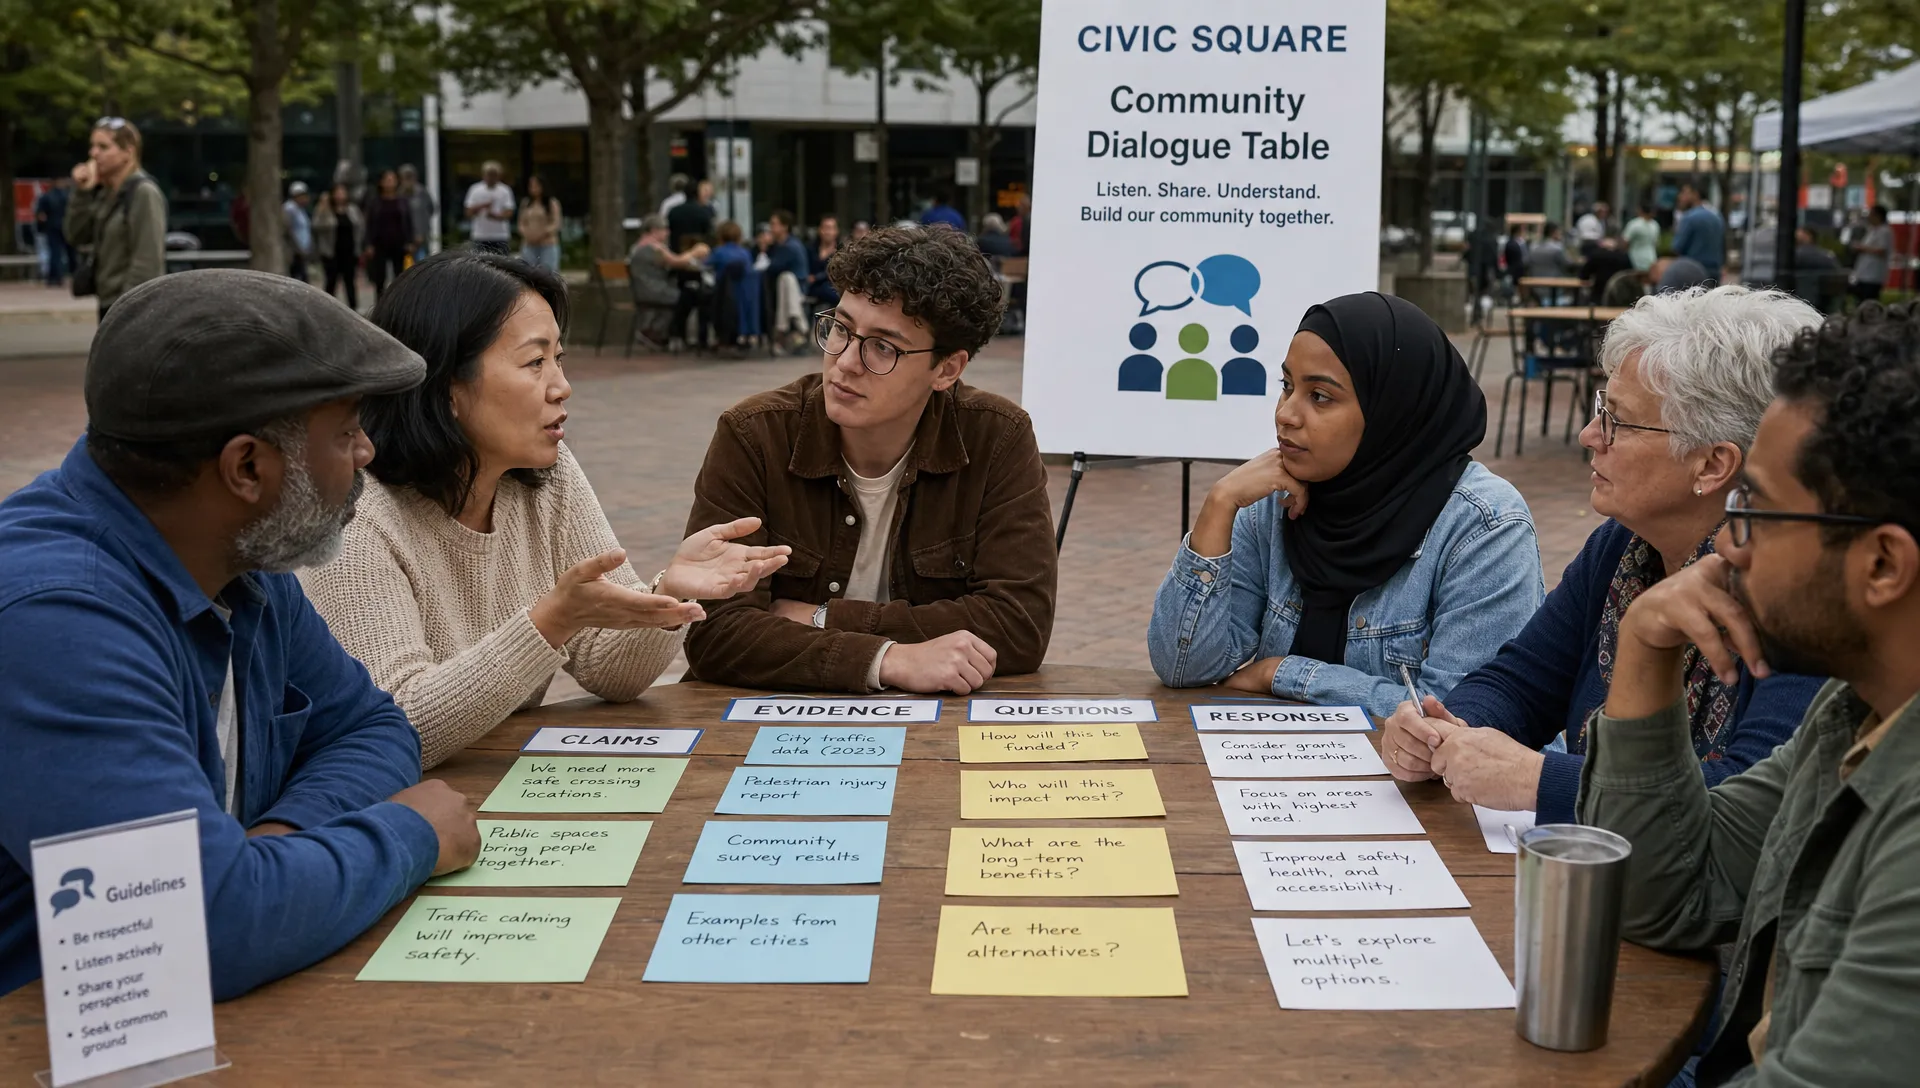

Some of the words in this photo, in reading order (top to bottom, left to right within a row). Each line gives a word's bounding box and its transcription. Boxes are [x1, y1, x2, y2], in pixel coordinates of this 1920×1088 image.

[1078, 25, 1177, 53] CIVIC
[1191, 25, 1347, 55] SQUARE
[1111, 85, 1305, 122] Community
[1088, 130, 1231, 166] Dialogue
[1241, 131, 1329, 160] Table
[1097, 181, 1151, 197] Listen.
[1158, 182, 1211, 198] Share.
[1218, 183, 1320, 199] Understand.
[1081, 206, 1122, 222] Build
[1127, 210, 1155, 222] our
[1160, 208, 1254, 228] community
[1259, 209, 1333, 228] together.
[754, 705, 912, 716] EVIDENCE
[994, 706, 1133, 716] QUESTIONS
[1210, 712, 1349, 722] RESPONSES
[561, 735, 660, 745] CLAIMS
[776, 733, 811, 745] City
[821, 733, 875, 742] traffic
[981, 731, 1017, 740] How
[1026, 731, 1053, 739] will
[1063, 730, 1093, 738] this
[1102, 729, 1121, 737] be
[772, 746, 809, 754] data
[820, 745, 886, 757] (2023)
[1004, 741, 1079, 751] funded?
[1221, 741, 1286, 749] Consider
[1296, 741, 1346, 752] grants
[1225, 752, 1253, 760] and
[1261, 752, 1362, 763] partnerships.
[531, 763, 556, 773] We
[567, 764, 607, 773] need
[617, 766, 656, 774] more
[522, 776, 560, 785] safe
[570, 777, 641, 788] crossing
[744, 776, 830, 786] Pedestrian
[840, 778, 887, 790] injury
[988, 780, 1027, 789] Who
[1038, 780, 1068, 789] will
[1079, 779, 1115, 788] this
[521, 789, 607, 798] locations.
[740, 791, 800, 802] report
[990, 793, 1051, 806] impact
[1065, 791, 1123, 801] most?
[1240, 788, 1288, 798] Focus
[1297, 791, 1317, 799] on
[1326, 790, 1372, 798] areas
[1242, 802, 1281, 810] with
[1292, 801, 1357, 813] highest
[1251, 813, 1303, 823] need.
[489, 827, 539, 838] Public
[550, 831, 608, 841] spaces
[727, 834, 836, 850] Community
[981, 837, 1033, 848] What
[1048, 840, 1081, 848] are
[1094, 837, 1125, 847] the
[483, 843, 528, 857] bring
[539, 842, 596, 855] people
[478, 857, 564, 871] together.
[717, 854, 782, 866] survey
[795, 852, 859, 861] results
[1261, 852, 1346, 865] Improved
[1358, 851, 1416, 865] safety,
[980, 867, 1079, 879] benefits?
[1269, 867, 1333, 878] health,
[1345, 866, 1379, 876] and
[106, 877, 186, 903] Guidelines
[1276, 881, 1402, 895] accessibility.
[427, 908, 488, 922] Traffic
[499, 912, 571, 928] calming
[687, 911, 779, 930] Examples
[793, 913, 836, 926] from
[73, 933, 89, 946] Be
[93, 918, 153, 940] respectful
[971, 921, 1011, 935] Are
[1027, 923, 1080, 935] there
[463, 930, 536, 945] improve
[682, 933, 737, 945] other
[750, 934, 809, 946] cities
[1285, 933, 1342, 947] Let's
[1358, 933, 1435, 950] explore
[75, 955, 113, 971] Listen
[116, 942, 163, 962] actively
[405, 947, 479, 965] safety.
[1293, 953, 1383, 969] multiple
[77, 980, 113, 996] Share
[116, 972, 144, 990] your
[1301, 973, 1400, 990] options.
[79, 987, 150, 1016] perspective
[81, 1022, 111, 1039] Seek
[114, 1010, 168, 1030] common
[81, 1033, 127, 1058] ground
